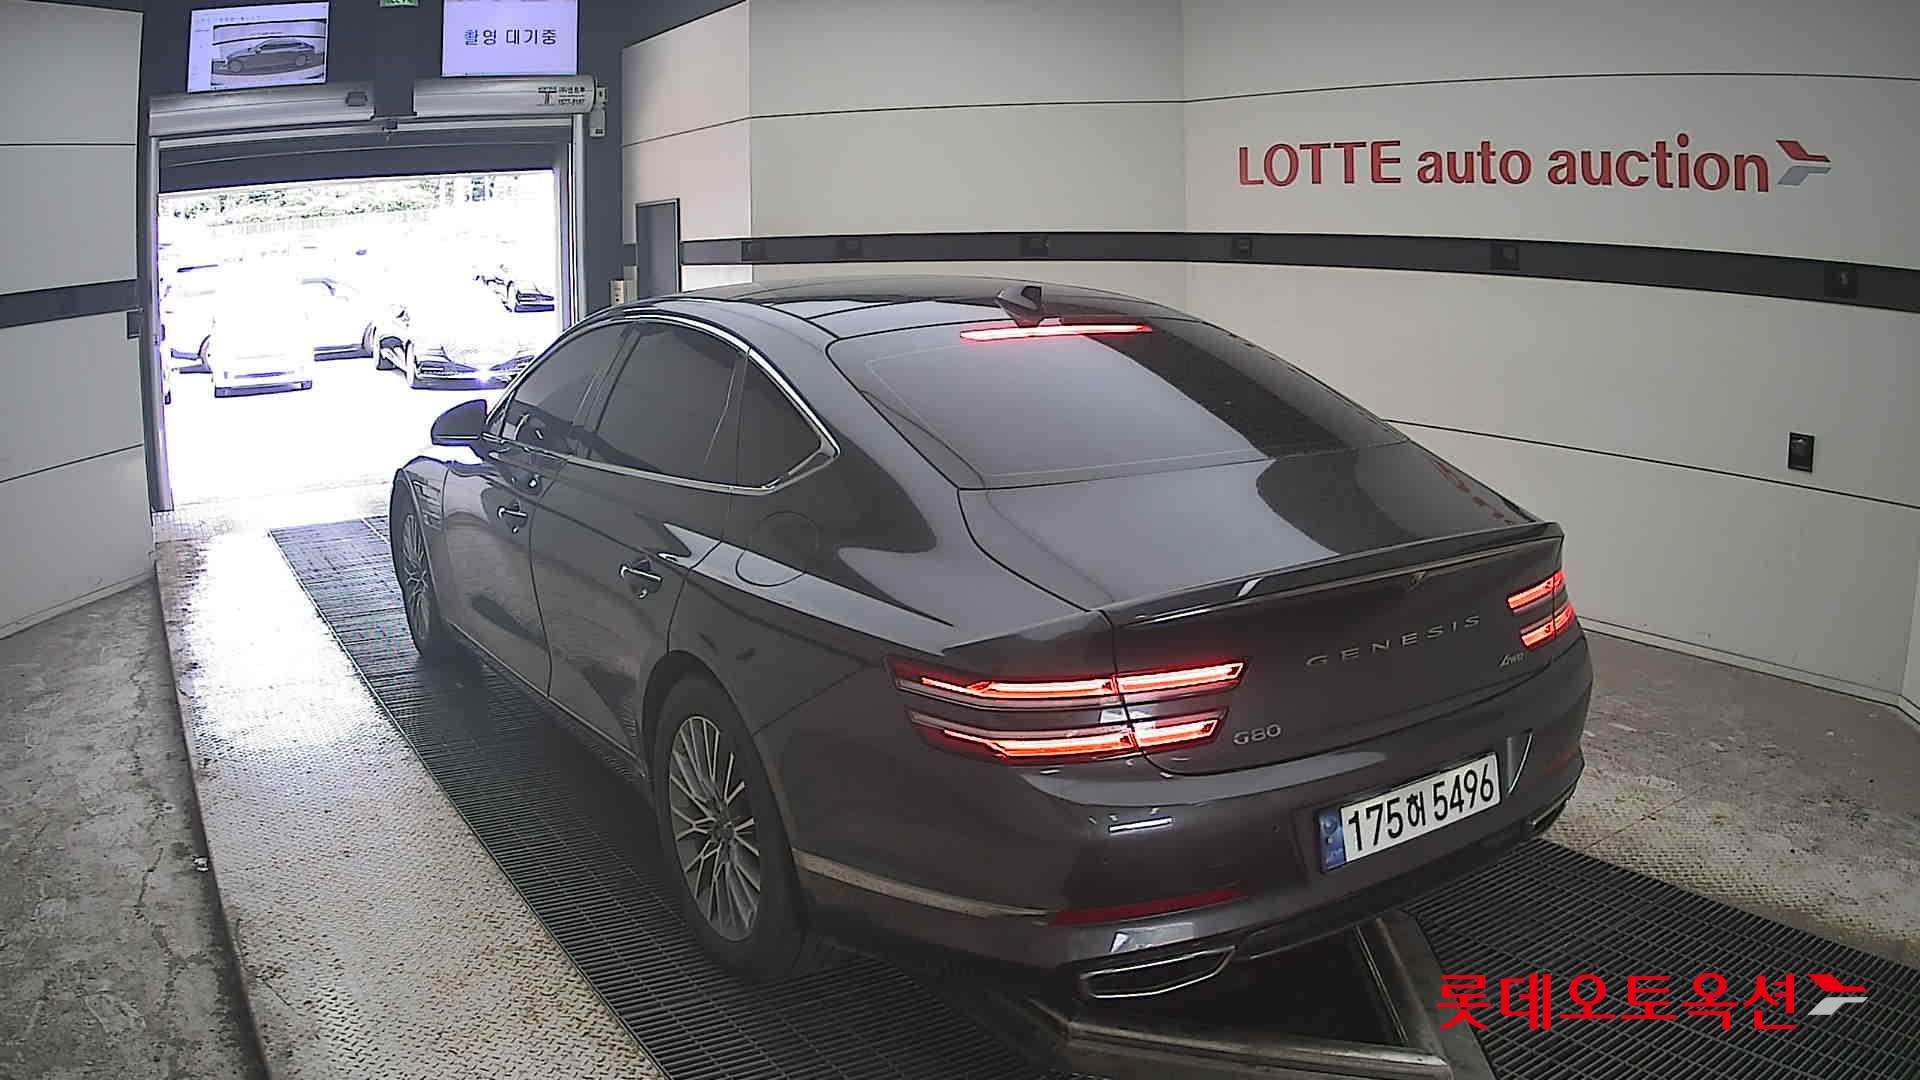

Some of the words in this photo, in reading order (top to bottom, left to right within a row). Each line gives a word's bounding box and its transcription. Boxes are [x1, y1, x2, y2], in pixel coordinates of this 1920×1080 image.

[505, 29, 556, 45] 대기중
[1239, 140, 1401, 186] LOTTE
[1416, 141, 1532, 184] auto
[1547, 133, 1769, 192] auction
[1306, 614, 1481, 667] GENESIS
[1233, 723, 1282, 746] G80
[1433, 763, 1494, 821] 5496
